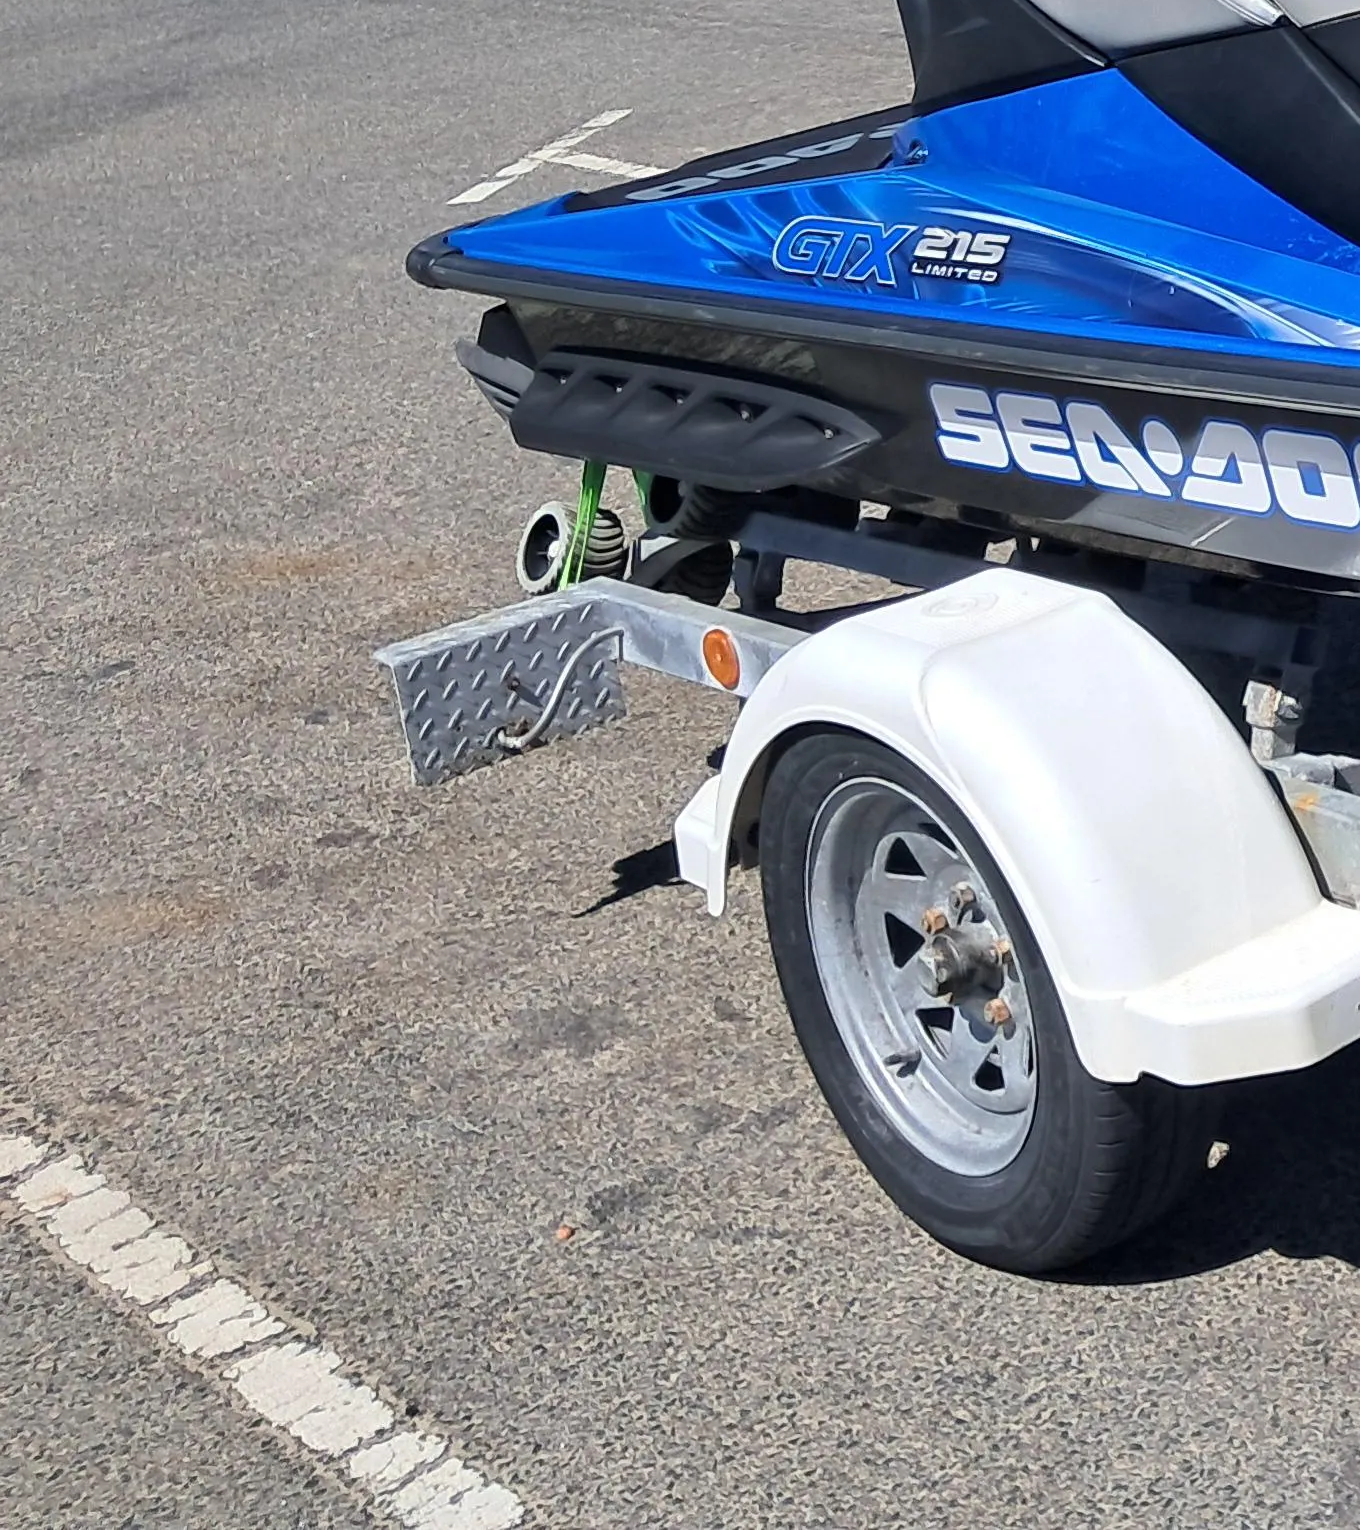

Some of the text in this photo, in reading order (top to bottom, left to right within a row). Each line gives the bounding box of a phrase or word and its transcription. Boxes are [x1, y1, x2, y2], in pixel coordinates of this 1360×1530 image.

[773, 215, 1011, 288] GTX 215
[910, 261, 998, 283] LIMITED
